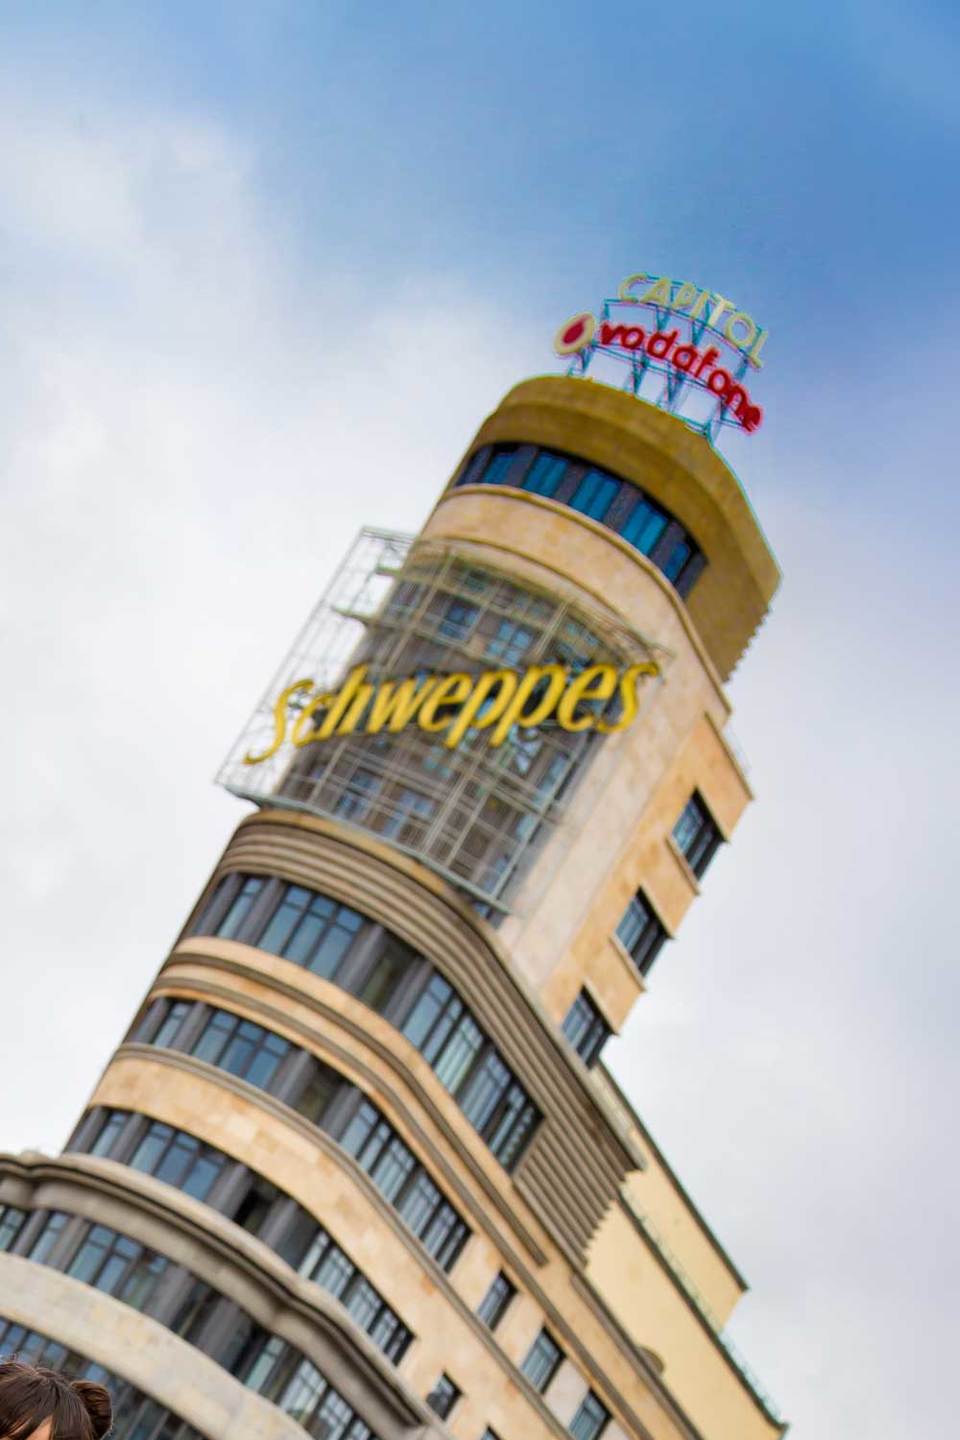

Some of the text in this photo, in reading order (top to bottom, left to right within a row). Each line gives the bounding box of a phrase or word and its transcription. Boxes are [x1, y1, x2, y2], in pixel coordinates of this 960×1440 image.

[618, 272, 768, 369] CAPITOL
[599, 321, 763, 433] vodafone
[244, 661, 659, 765] Schweppes
